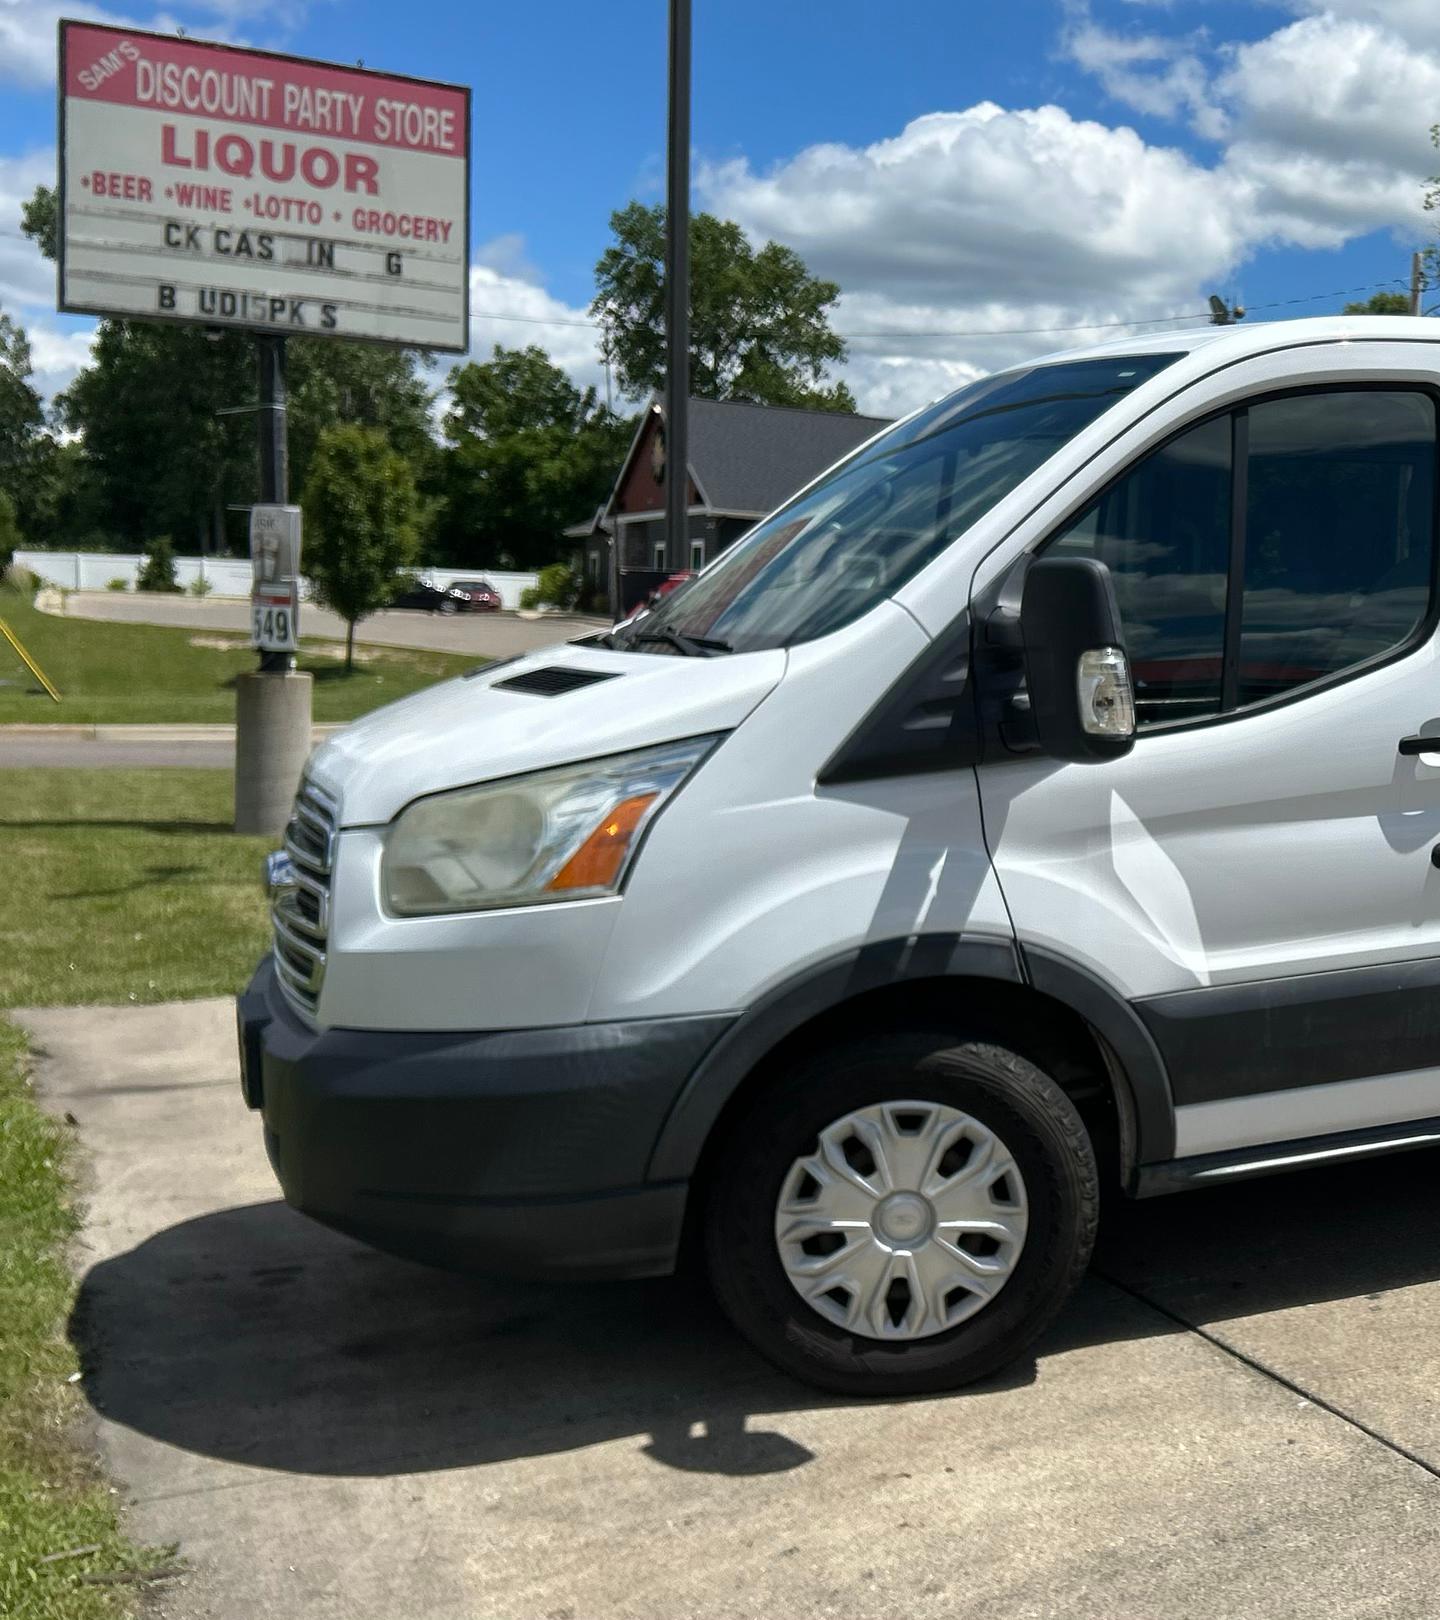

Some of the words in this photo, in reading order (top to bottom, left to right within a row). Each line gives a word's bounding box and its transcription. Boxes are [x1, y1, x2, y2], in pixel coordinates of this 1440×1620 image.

[78, 41, 140, 91] SAM'S
[136, 59, 275, 120] DISCOUNT
[283, 83, 365, 135] PARTY
[374, 97, 456, 150] STORE
[161, 123, 379, 196] LIQUOR
[164, 223, 201, 249] CK
[386, 252, 403, 275] G
[351, 207, 454, 244] GROCERY
